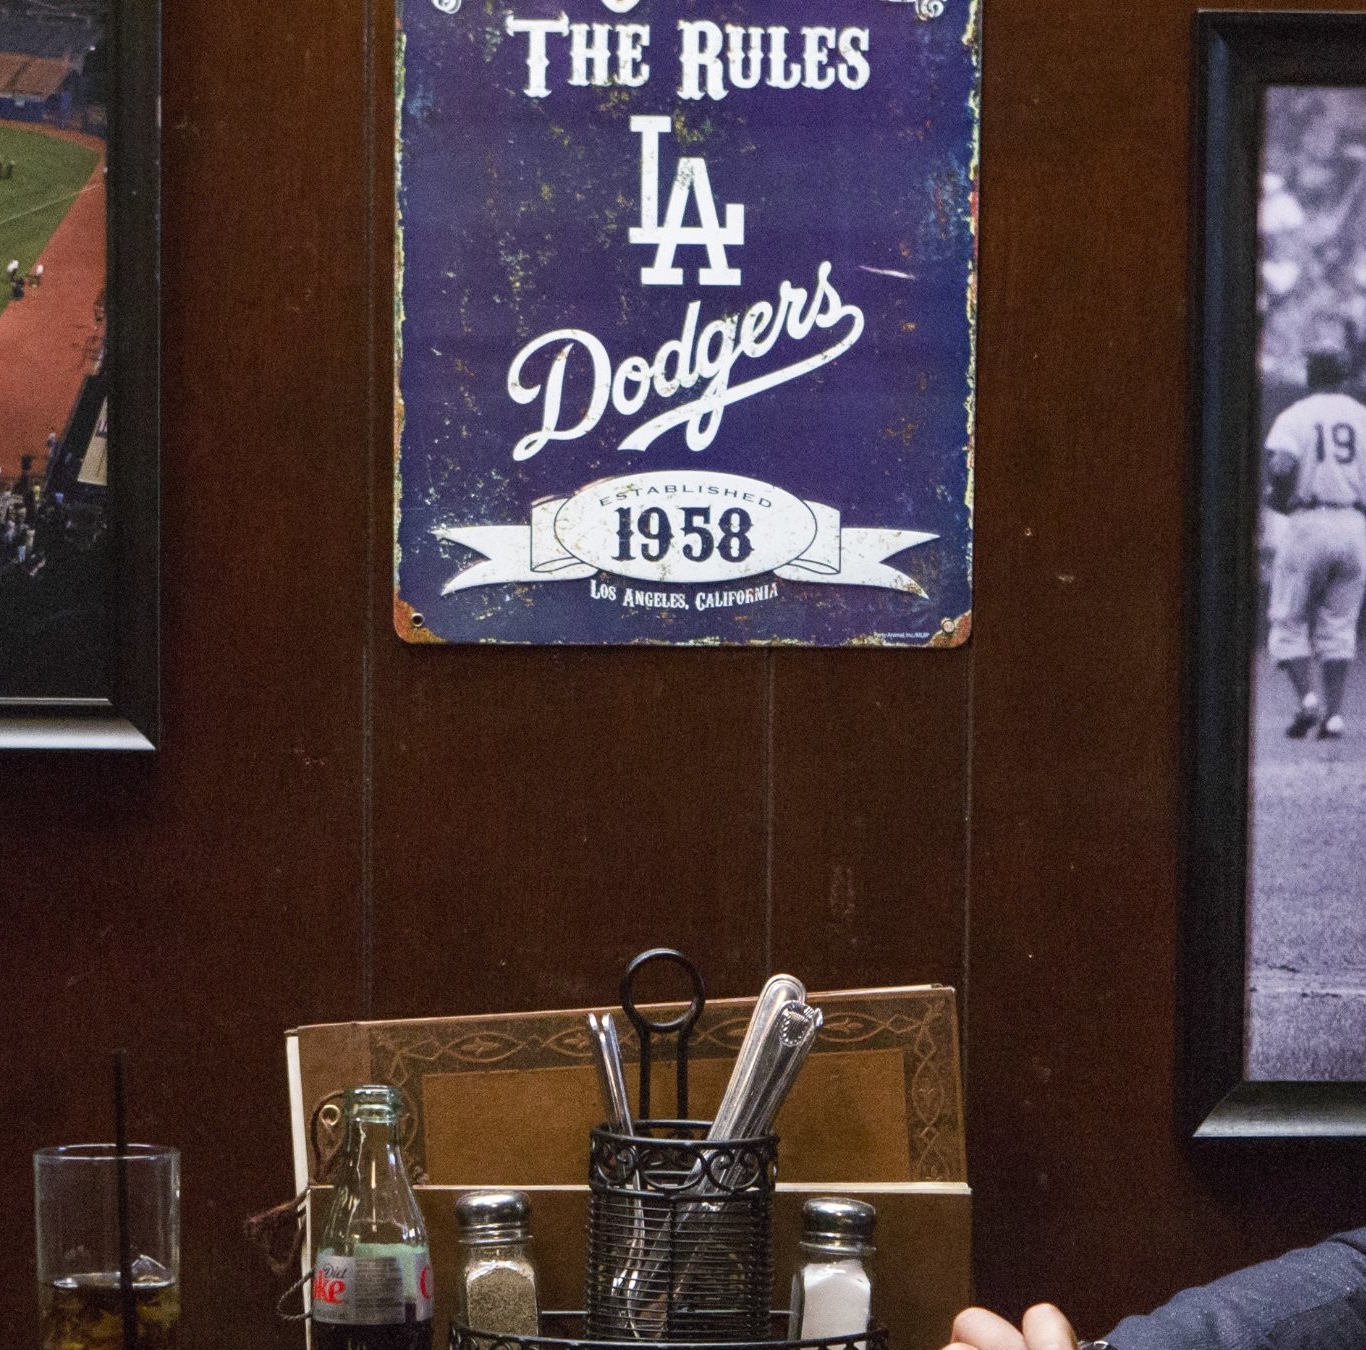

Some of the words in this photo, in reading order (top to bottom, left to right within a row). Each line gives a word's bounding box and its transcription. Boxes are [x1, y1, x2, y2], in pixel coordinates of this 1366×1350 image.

[629, 115, 745, 286] LA
[507, 261, 865, 461] Dodgers
[1315, 422, 1356, 465] 19
[599, 484, 773, 509] ESTABLISHED
[611, 505, 756, 563] 1958
[590, 579, 617, 601] LOS
[695, 582, 779, 611] CALIFORNIA
[323, 1264, 348, 1279] Diet
